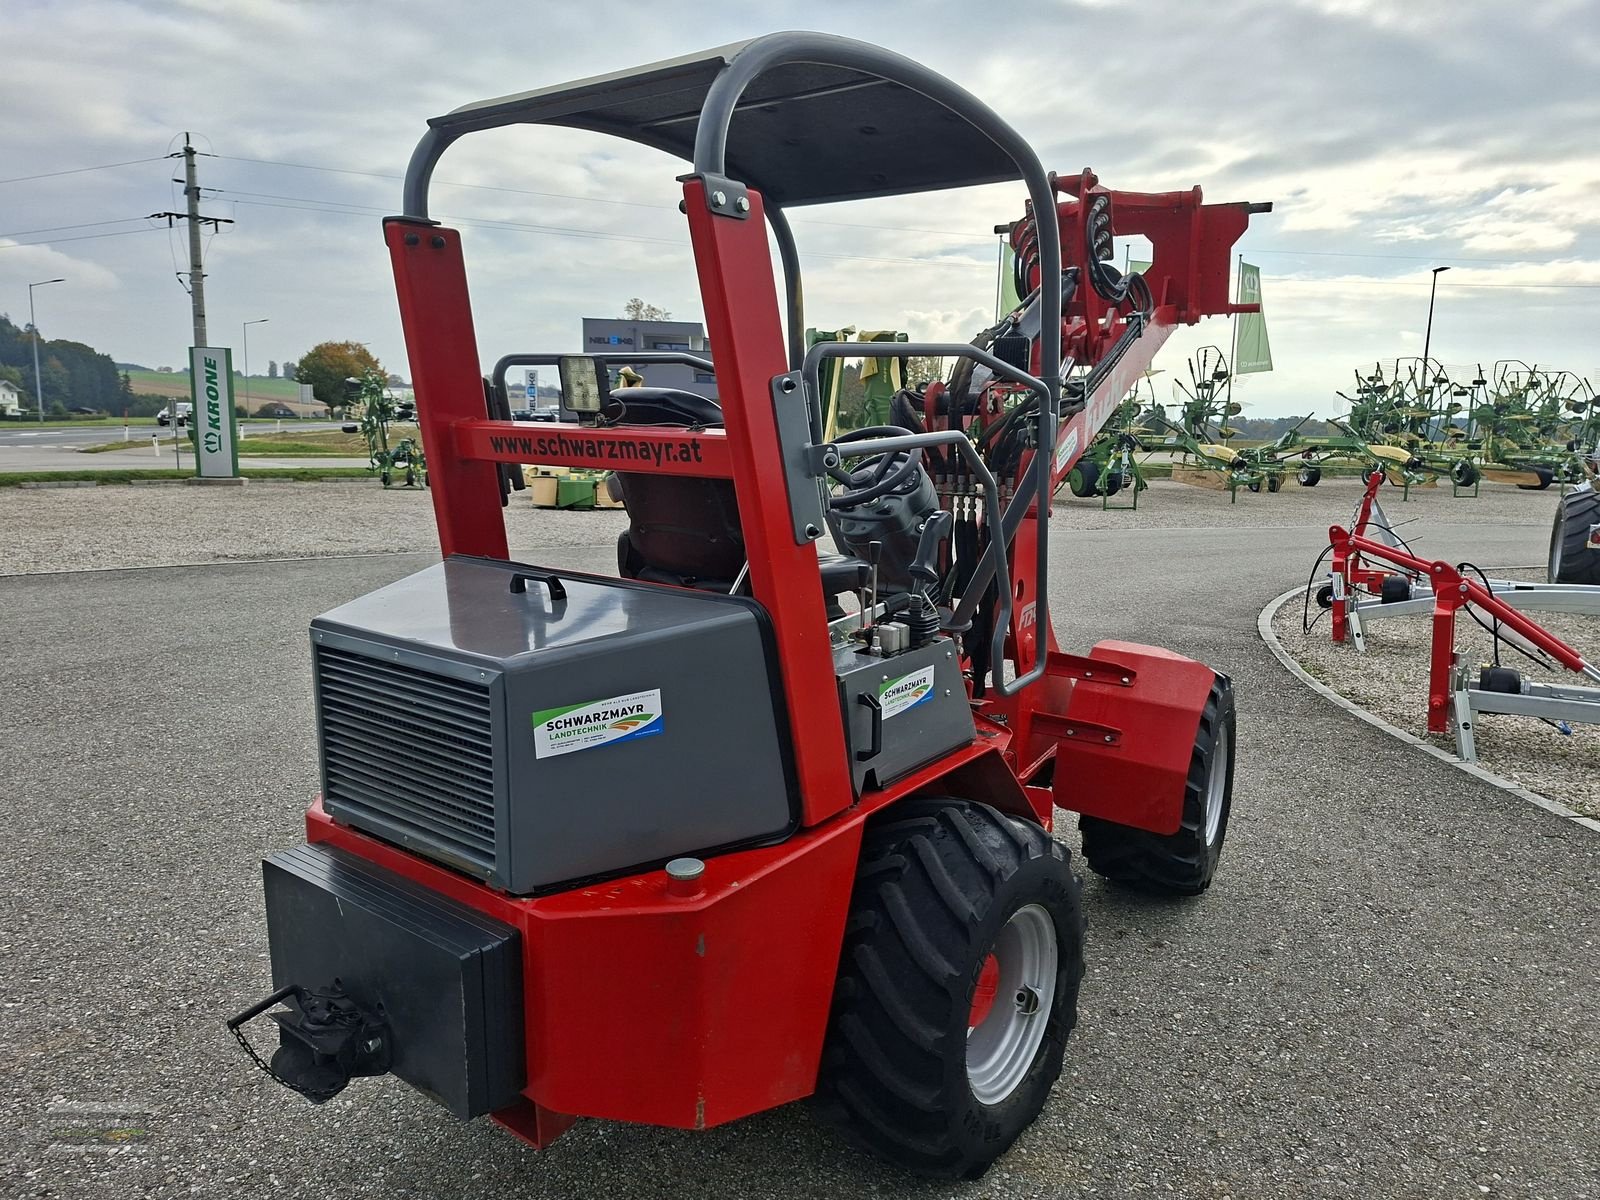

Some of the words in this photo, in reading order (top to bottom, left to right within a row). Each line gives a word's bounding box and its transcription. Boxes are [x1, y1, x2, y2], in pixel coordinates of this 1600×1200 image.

[204, 356, 221, 431] KRONE
[490, 433, 702, 467] www.schwarzmayr.at
[884, 677, 927, 700] SCHWARZMAYR
[546, 704, 645, 732] SCHWARZMAYR
[549, 723, 608, 741] LANDTECHNIK
